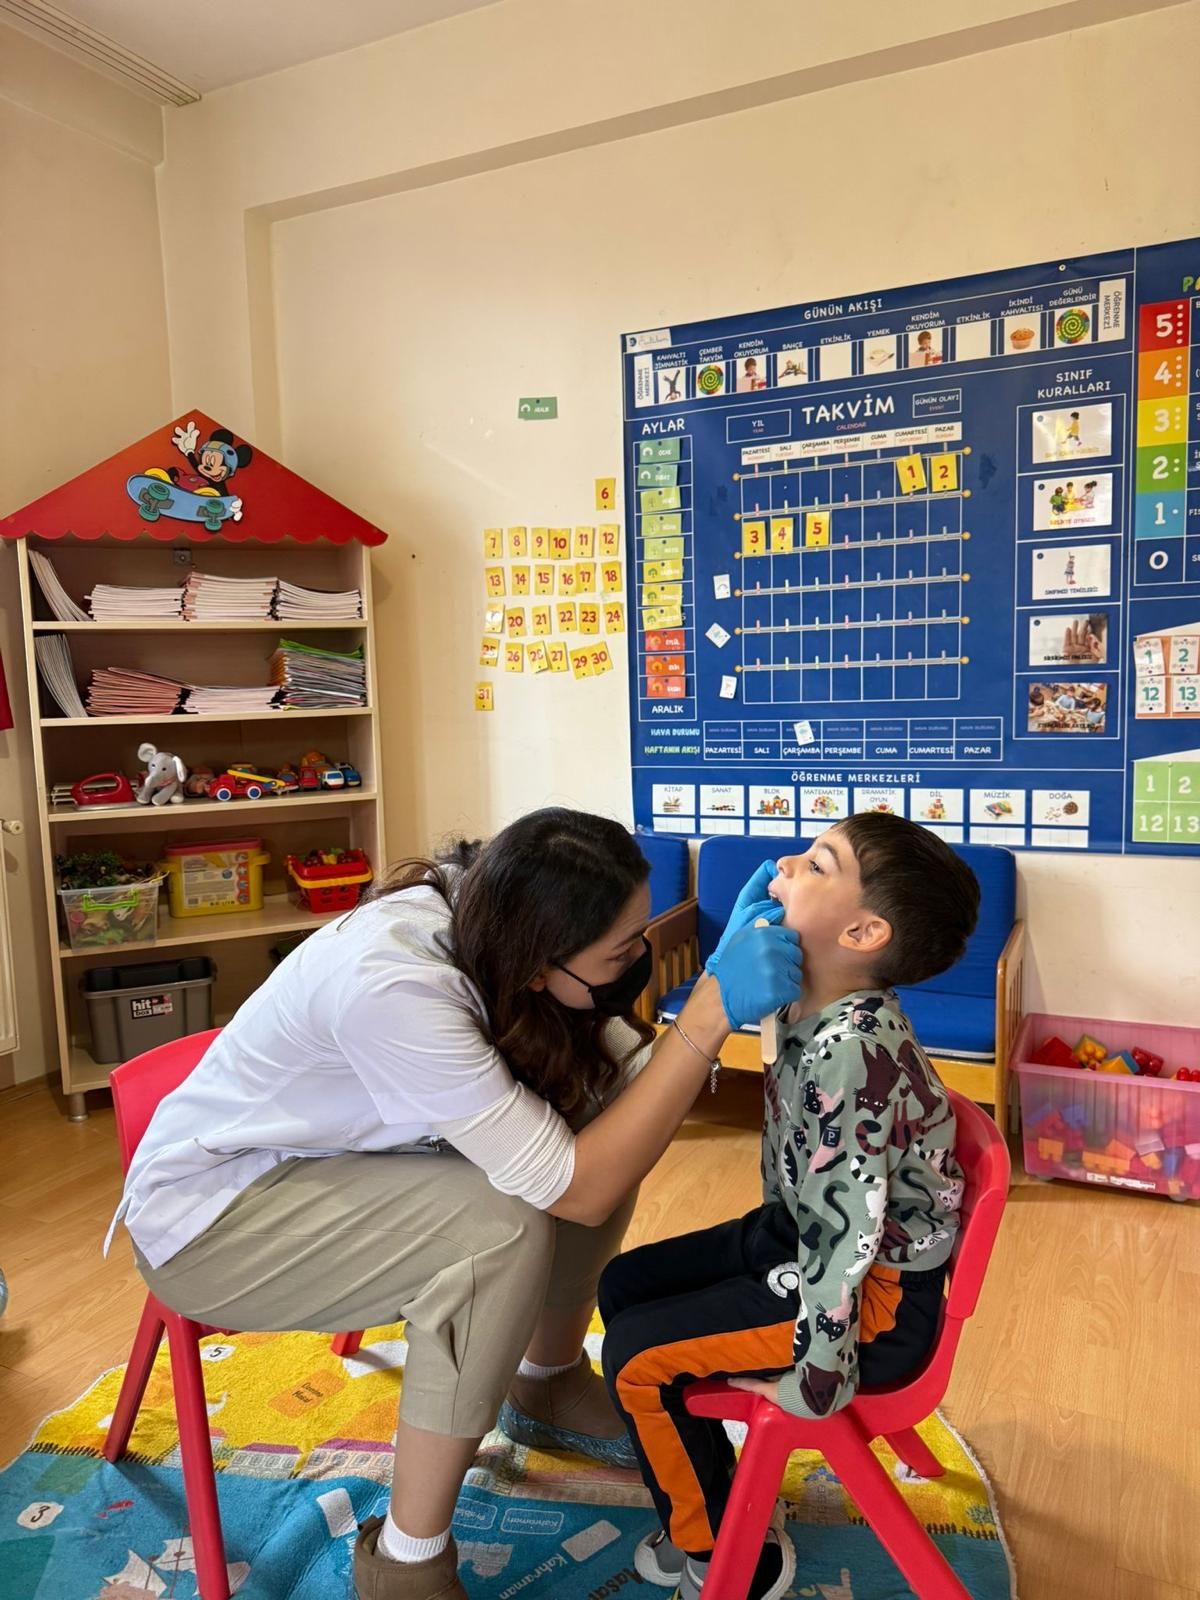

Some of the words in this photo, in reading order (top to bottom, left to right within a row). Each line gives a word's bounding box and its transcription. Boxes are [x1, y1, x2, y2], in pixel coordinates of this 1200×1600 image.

[1063, 286, 1083, 297] GÜNÜ
[1009, 296, 1033, 307] İKİNDİ
[1049, 293, 1097, 307] DEĞERLENDİR
[804, 301, 843, 321] GÜNÜN
[848, 298, 883, 313] AKIŞI
[1001, 304, 1043, 317] KAHVALTISI
[1104, 295, 1113, 330] MERKEZİ
[1113, 290, 1123, 328] ÖĞRENME
[911, 311, 940, 322] KENDİM
[956, 312, 990, 324] ETKİNLİK
[905, 319, 945, 332] OKUYORUM
[1155, 313, 1174, 339] 5
[867, 328, 890, 337] YEMEK
[738, 339, 764, 350] KENDİM
[820, 333, 851, 345] ETKİNLİK
[699, 346, 724, 358] ÇEMBER
[734, 346, 769, 358] OKUYORUM
[782, 342, 804, 352] BAHÇE
[657, 352, 687, 362] KAHVALTI
[699, 354, 724, 364] TAKVİM
[654, 359, 689, 370] JİMNASTİK
[1056, 369, 1093, 383] SINIF
[1153, 361, 1173, 385] 4
[1037, 380, 1111, 400] KURALLARI
[802, 394, 895, 426] TAKVİM
[641, 417, 686, 435] AYLAR
[752, 419, 765, 428] YIL
[1153, 408, 1170, 433] 3
[906, 466, 915, 479] 1
[939, 466, 949, 479] 2
[1152, 456, 1169, 480] 2
[601, 488, 609, 500] 6
[1154, 502, 1166, 525] 1
[777, 527, 787, 540] 4
[812, 522, 822, 535] 5
[490, 538, 497, 549] 7
[513, 535, 520, 546] 8
[536, 536, 543, 547] 9
[553, 537, 567, 549] 10
[579, 534, 589, 546] 11
[603, 532, 614, 545] 12
[750, 531, 759, 544] 3
[490, 575, 501, 586] 13
[515, 574, 527, 585] 14
[538, 573, 550, 584] 15
[562, 574, 574, 585] 16
[579, 572, 591, 583] 17
[604, 570, 617, 582] 18
[508, 615, 523, 627] 20
[536, 614, 547, 625] 21
[560, 611, 573, 622] 22
[582, 610, 596, 623] 23
[606, 610, 620, 623] 24
[507, 650, 520, 662] 26
[530, 649, 543, 660] 28
[551, 650, 563, 662] 27
[592, 650, 608, 664] 30
[1145, 650, 1153, 665] 1
[1178, 648, 1189, 662] 2
[573, 654, 588, 668] 29
[478, 689, 489, 700] 31
[1142, 686, 1160, 701] 12
[1178, 685, 1197, 701] 13
[651, 704, 684, 714] ARALIK
[651, 728, 671, 736] HAVA
[672, 728, 700, 736] DURUMU
[705, 745, 742, 754] PAZARTESİ
[783, 746, 821, 756] ÇARŞAMBA
[824, 747, 862, 756] PERŞEMBE
[909, 745, 954, 754] CUMARTESİ
[790, 771, 843, 783] ÖĞRENME
[848, 772, 921, 784] MERKEZLERİ
[1146, 775, 1155, 792] 1
[1178, 776, 1191, 793] 2
[803, 788, 845, 796] MATEMATİK
[929, 790, 943, 798] DİL
[983, 790, 1011, 799] MÜZİK
[1048, 791, 1073, 800] DOĞA
[1139, 815, 1164, 833] 12
[1174, 816, 1199, 833] 13
[132, 999, 152, 1011] hit
[828, 1130, 835, 1141] P
[210, 1346, 222, 1358] 5
[31, 1505, 50, 1522] 3
[499, 1553, 568, 1600] Kahraman
